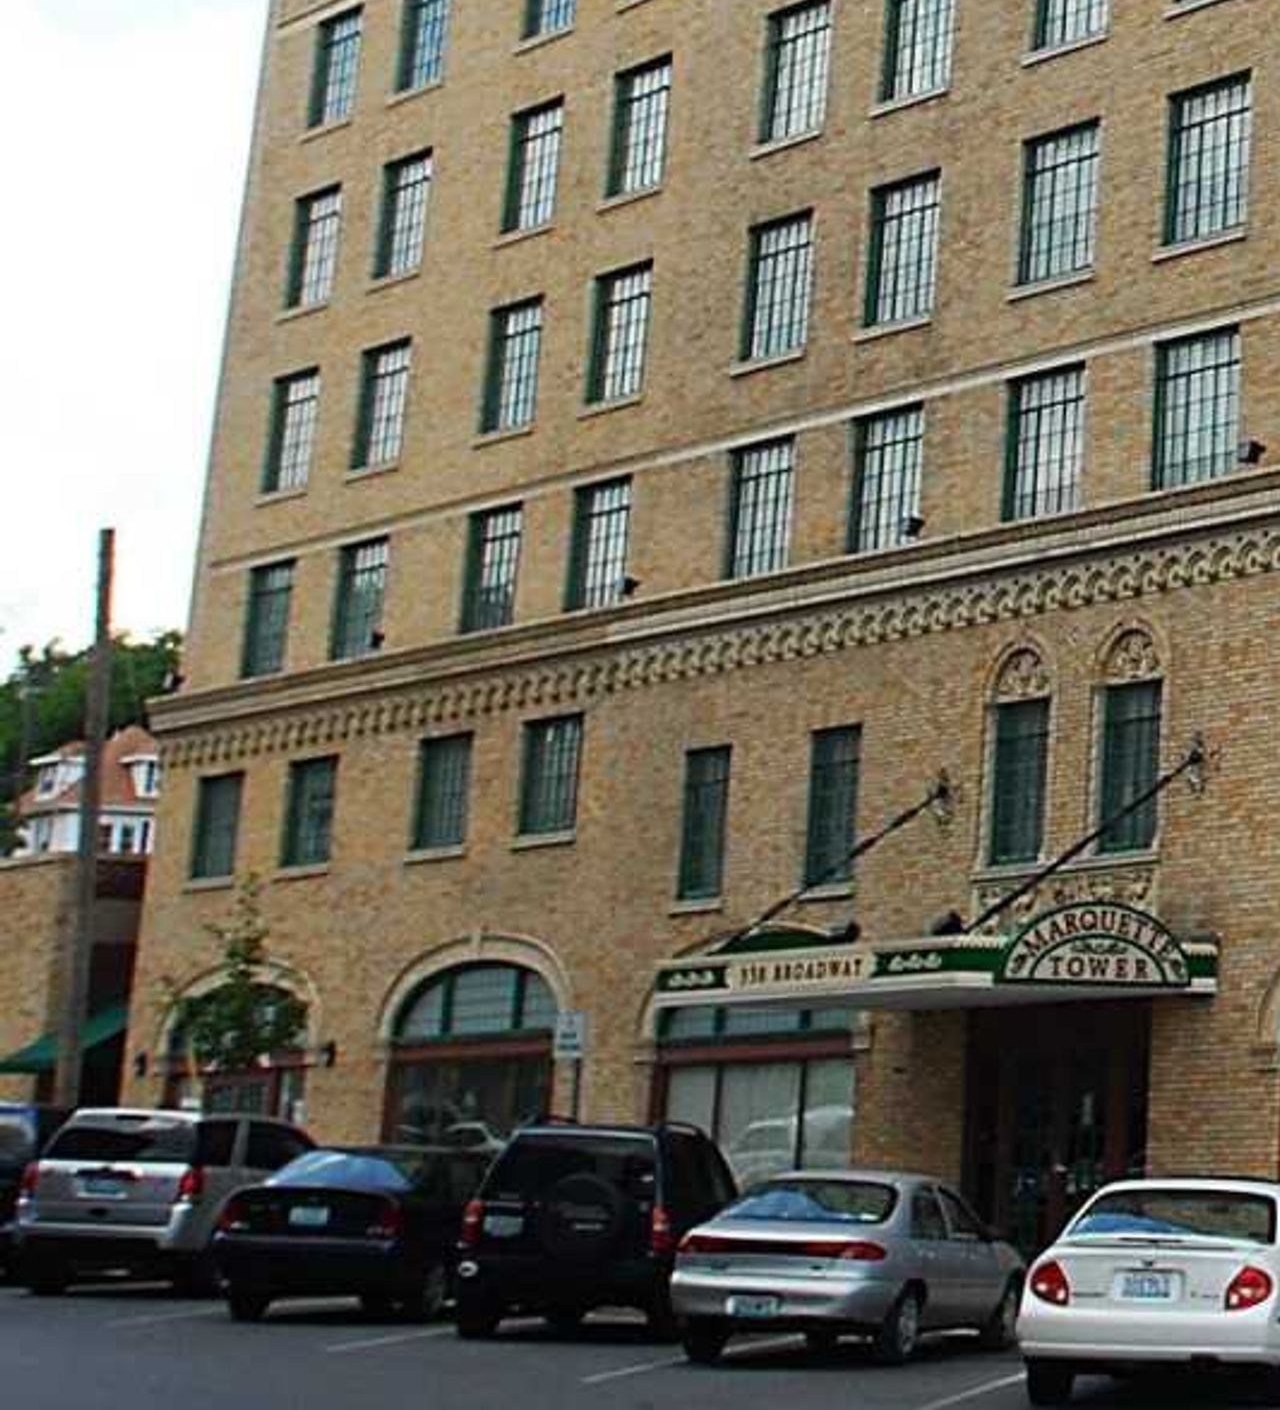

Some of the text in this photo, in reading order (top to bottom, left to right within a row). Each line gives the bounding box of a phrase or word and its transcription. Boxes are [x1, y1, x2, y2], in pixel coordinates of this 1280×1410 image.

[1023, 909, 1176, 960] MARQUETTE
[773, 958, 863, 981] BROADWAY
[1050, 956, 1149, 979] TOWER
